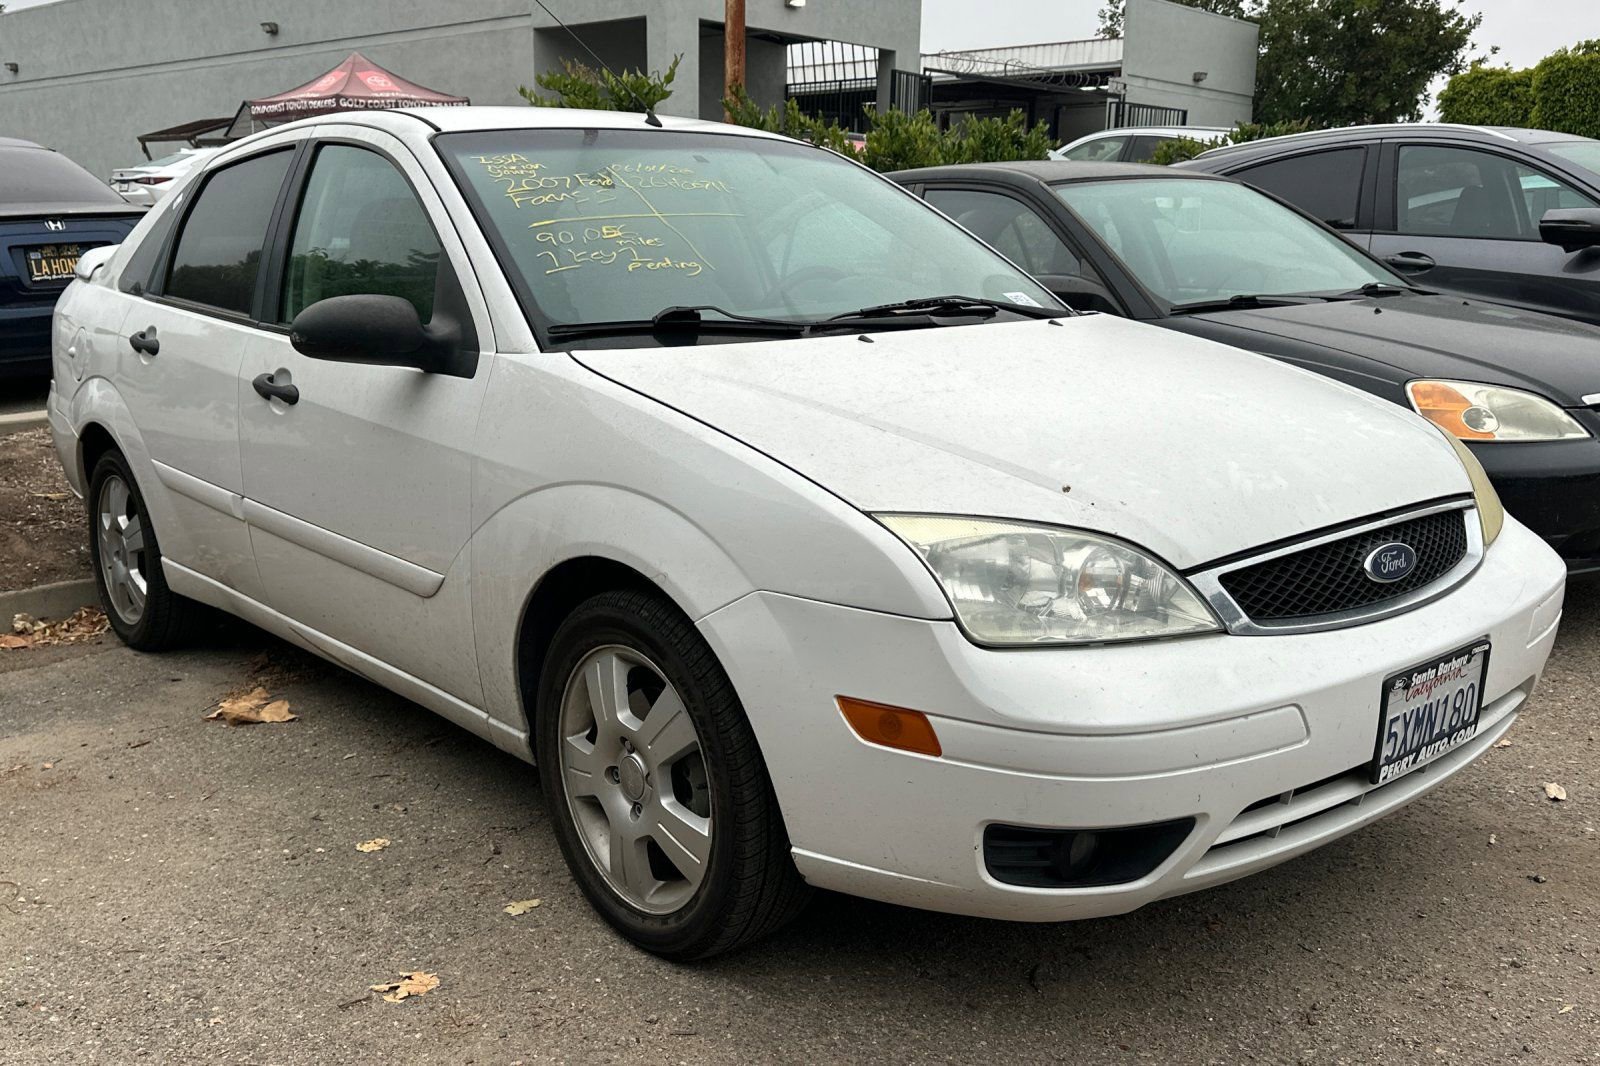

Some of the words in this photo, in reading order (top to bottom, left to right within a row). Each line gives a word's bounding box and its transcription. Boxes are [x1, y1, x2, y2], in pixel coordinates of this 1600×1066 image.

[339, 98, 365, 108] GOLD
[367, 99, 396, 108] COAST
[494, 177, 571, 193] 2007
[573, 171, 613, 187] Ford
[31, 259, 51, 276] LA
[1381, 551, 1407, 574] Ford
[1411, 667, 1437, 687] Santa
[1437, 653, 1469, 676] Barbara
[1405, 668, 1468, 703] California
[1384, 682, 1476, 764] 5XMN180
[1379, 752, 1417, 783] PERRY
[1417, 724, 1476, 763] AUTO.COM
